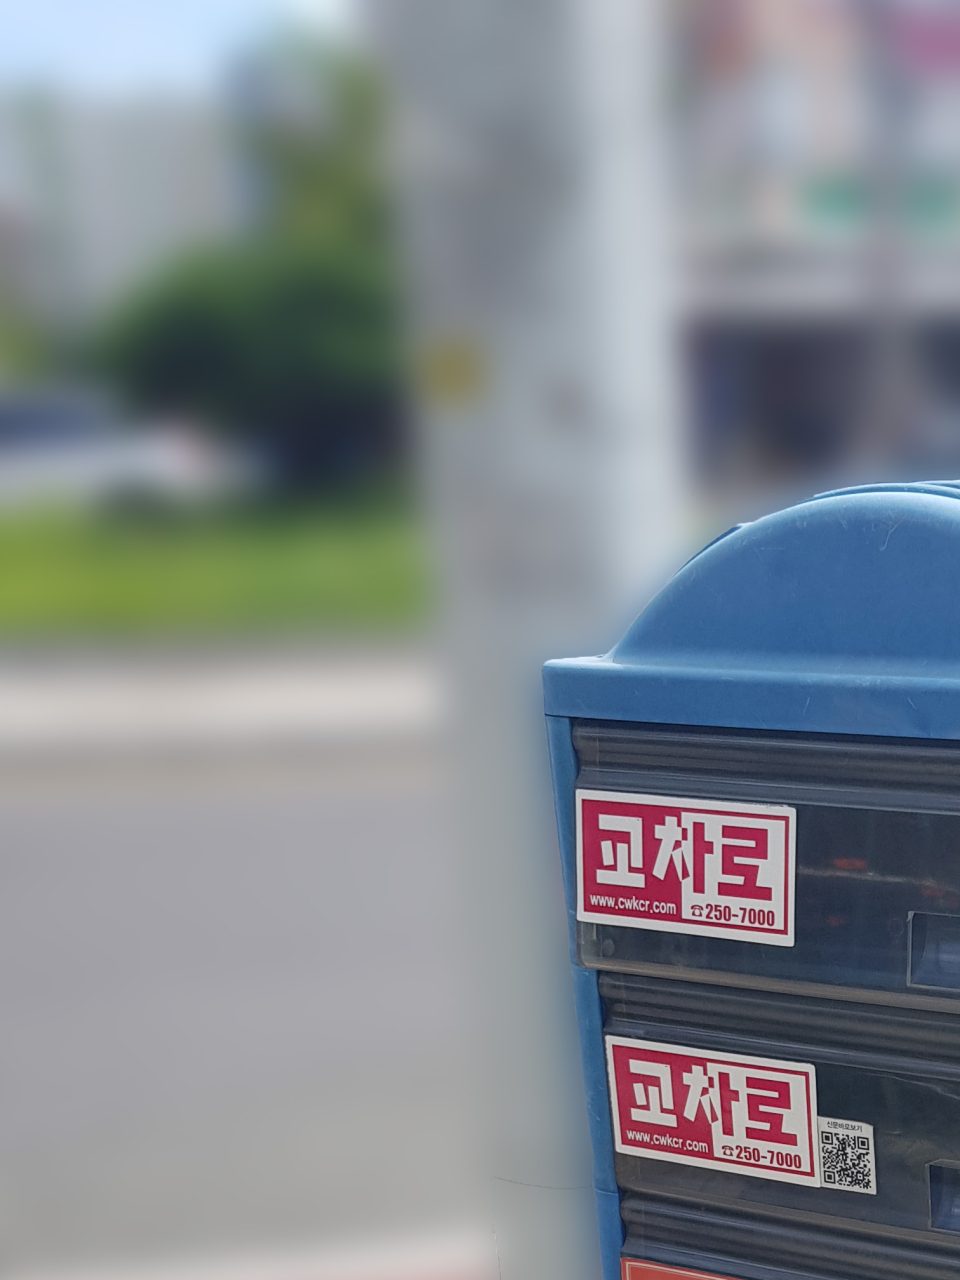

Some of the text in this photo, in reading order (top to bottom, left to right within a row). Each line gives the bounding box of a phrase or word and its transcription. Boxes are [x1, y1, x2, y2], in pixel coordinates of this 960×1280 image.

[596, 813, 772, 901] 교차로
[590, 894, 676, 915] www.cwkcr.com
[705, 903, 775, 927] 250-7000
[629, 1059, 798, 1147] 교차로
[626, 1129, 708, 1153] www.cwkcr.com
[736, 1145, 802, 1169] 250-7000
